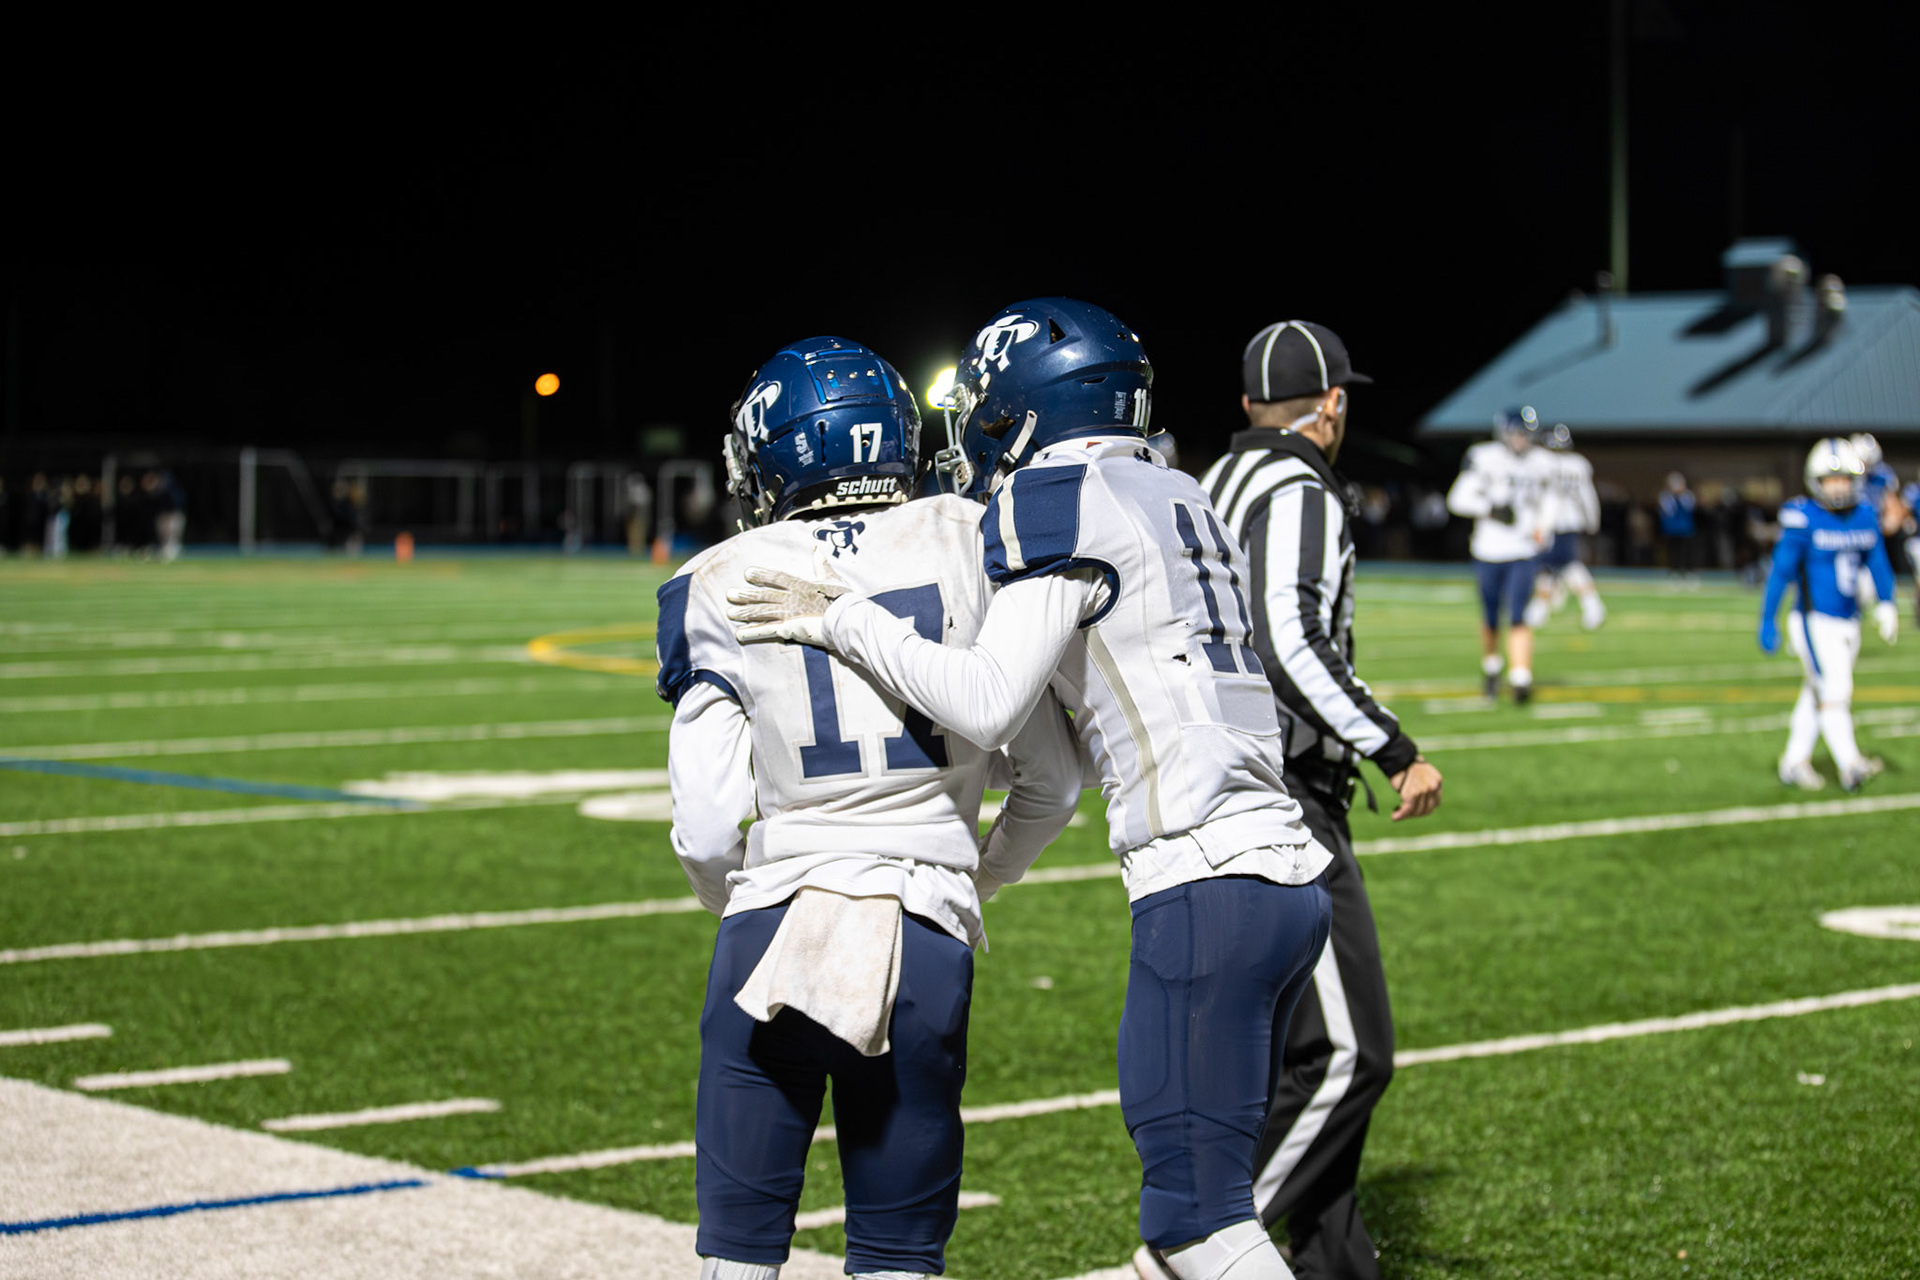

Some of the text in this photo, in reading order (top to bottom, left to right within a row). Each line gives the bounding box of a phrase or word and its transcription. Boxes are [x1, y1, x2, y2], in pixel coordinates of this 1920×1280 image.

[1132, 388, 1147, 427] 11
[849, 423, 883, 463] 17
[836, 476, 897, 496] schutt
[1171, 499, 1267, 678] 11
[792, 582, 950, 784] 17
